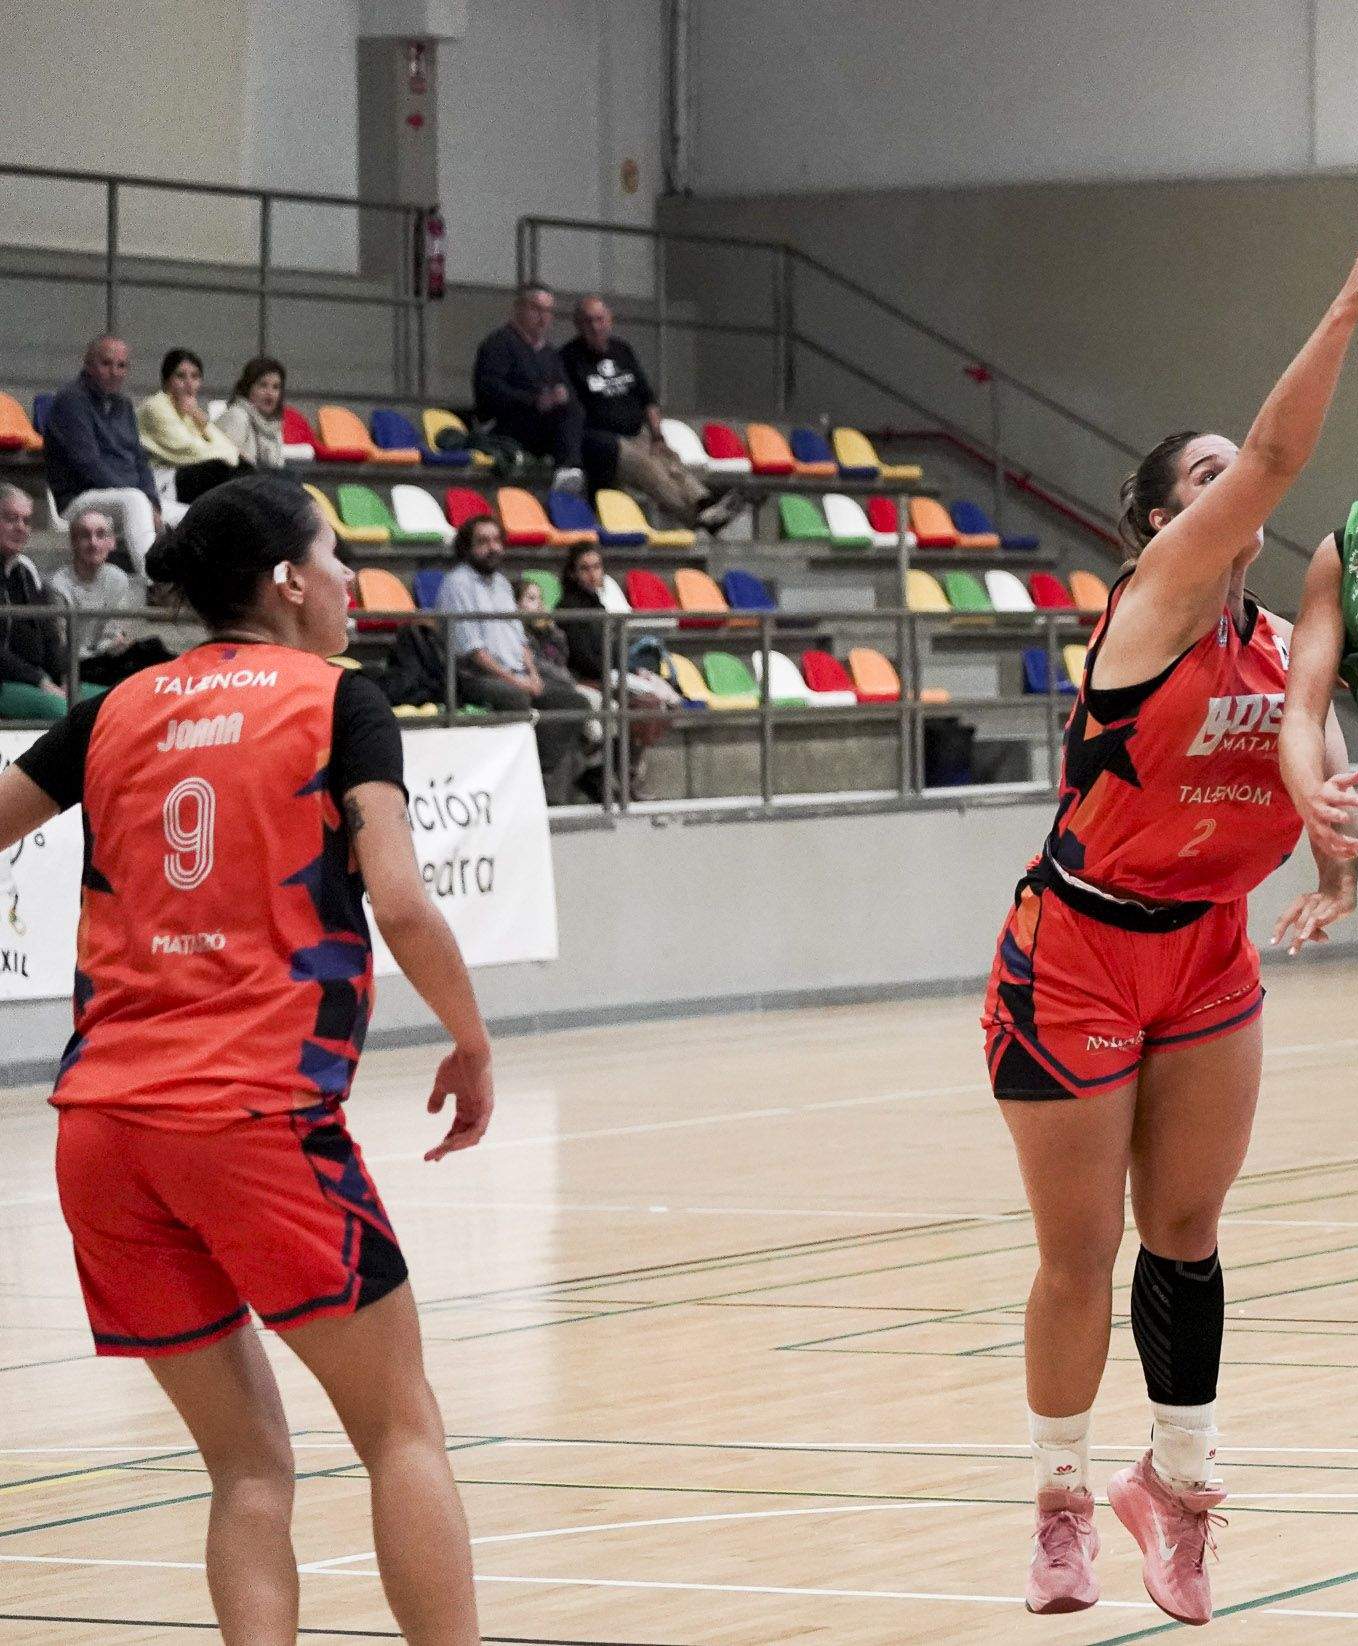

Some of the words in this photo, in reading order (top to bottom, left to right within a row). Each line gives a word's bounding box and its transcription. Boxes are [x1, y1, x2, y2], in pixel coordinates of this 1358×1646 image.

[154, 670, 278, 695] TALENOM
[1219, 736, 1280, 753] MATA
[408, 775, 492, 832] ción
[1180, 784, 1272, 807] TALENOM
[163, 776, 216, 891] 9
[1178, 818, 1217, 857] 2
